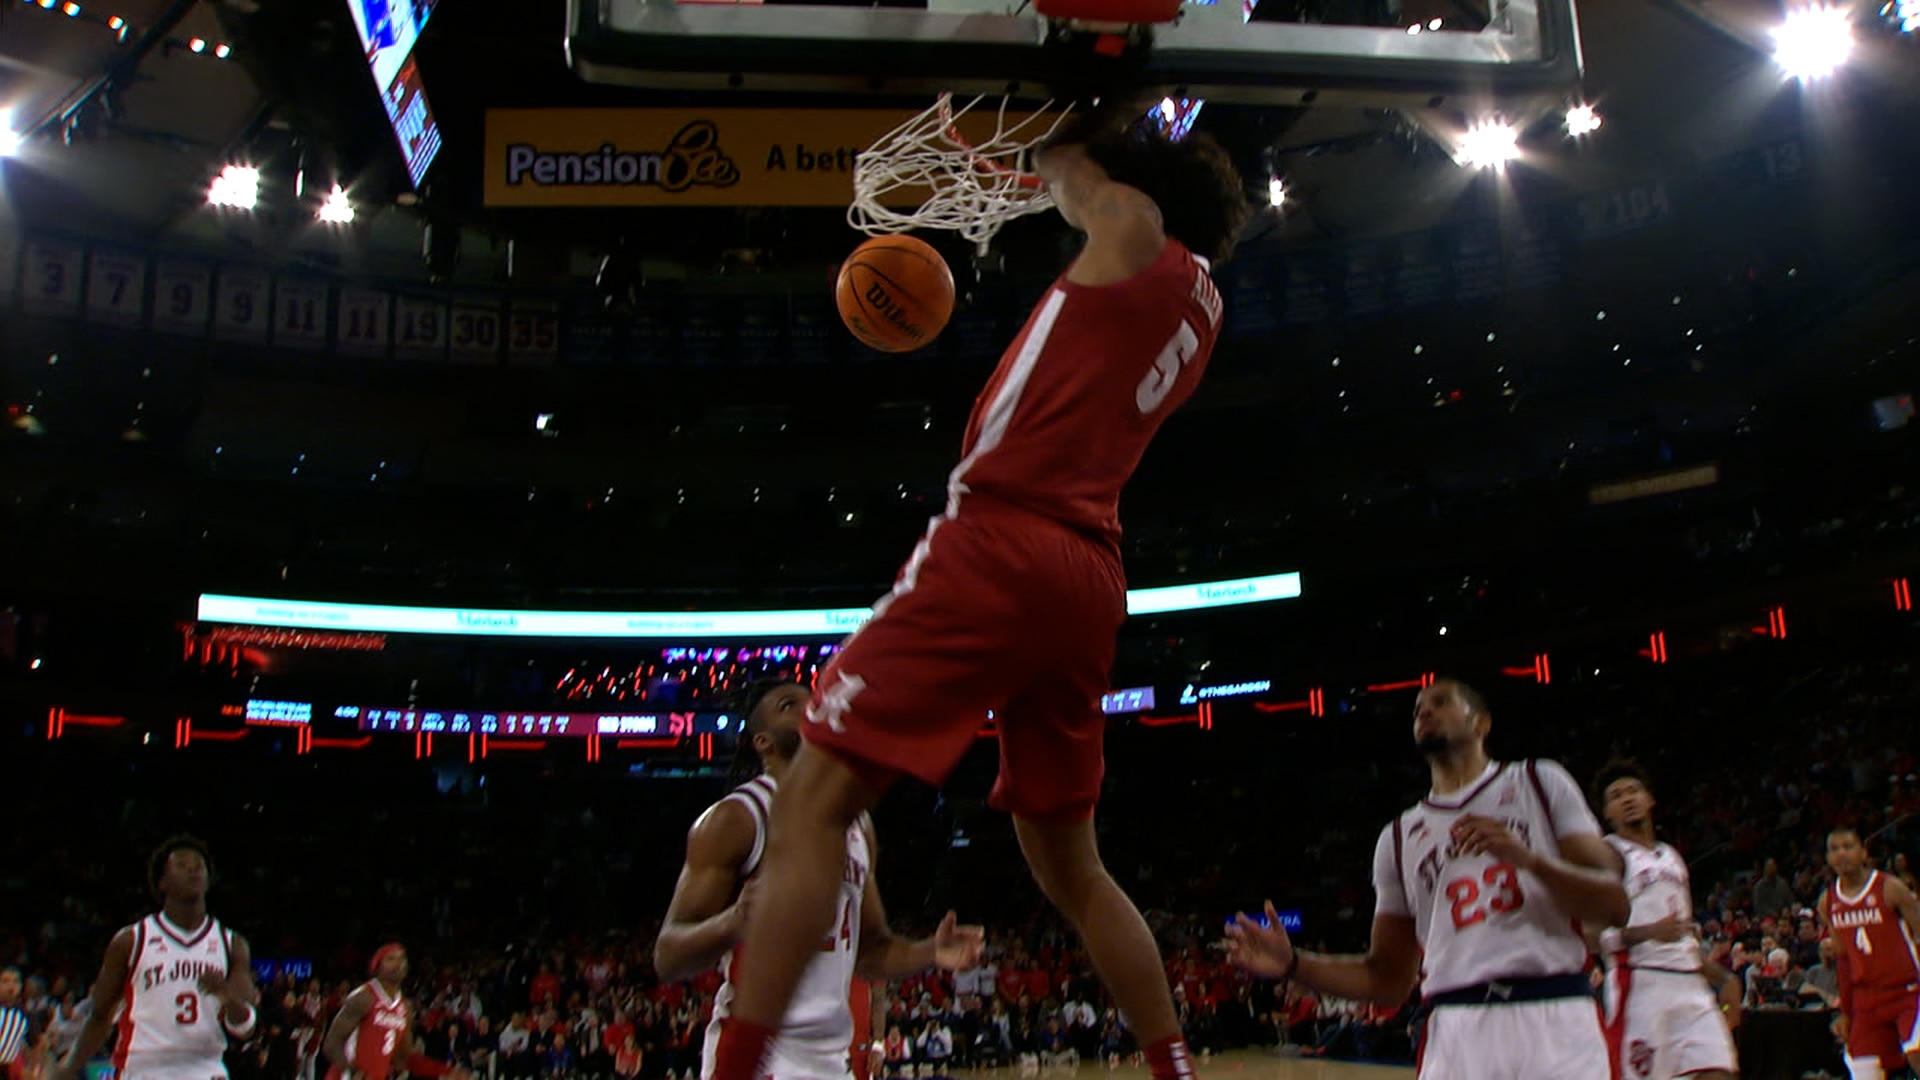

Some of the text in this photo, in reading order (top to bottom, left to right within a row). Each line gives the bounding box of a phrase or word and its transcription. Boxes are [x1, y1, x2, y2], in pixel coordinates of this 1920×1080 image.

[767, 145, 787, 171] A
[43, 263, 66, 295] 3
[107, 272, 129, 307] 7
[169, 282, 194, 317] 9
[285, 298, 315, 331] 11
[347, 308, 378, 340] 11
[402, 310, 438, 342] 19
[455, 314, 497, 347] 30
[512, 316, 556, 349] 35
[1135, 318, 1200, 415] 5
[1446, 861, 1524, 933] 23
[1831, 907, 1884, 929] ALABAMA
[1856, 925, 1872, 954] 4
[175, 991, 199, 1025] 3
